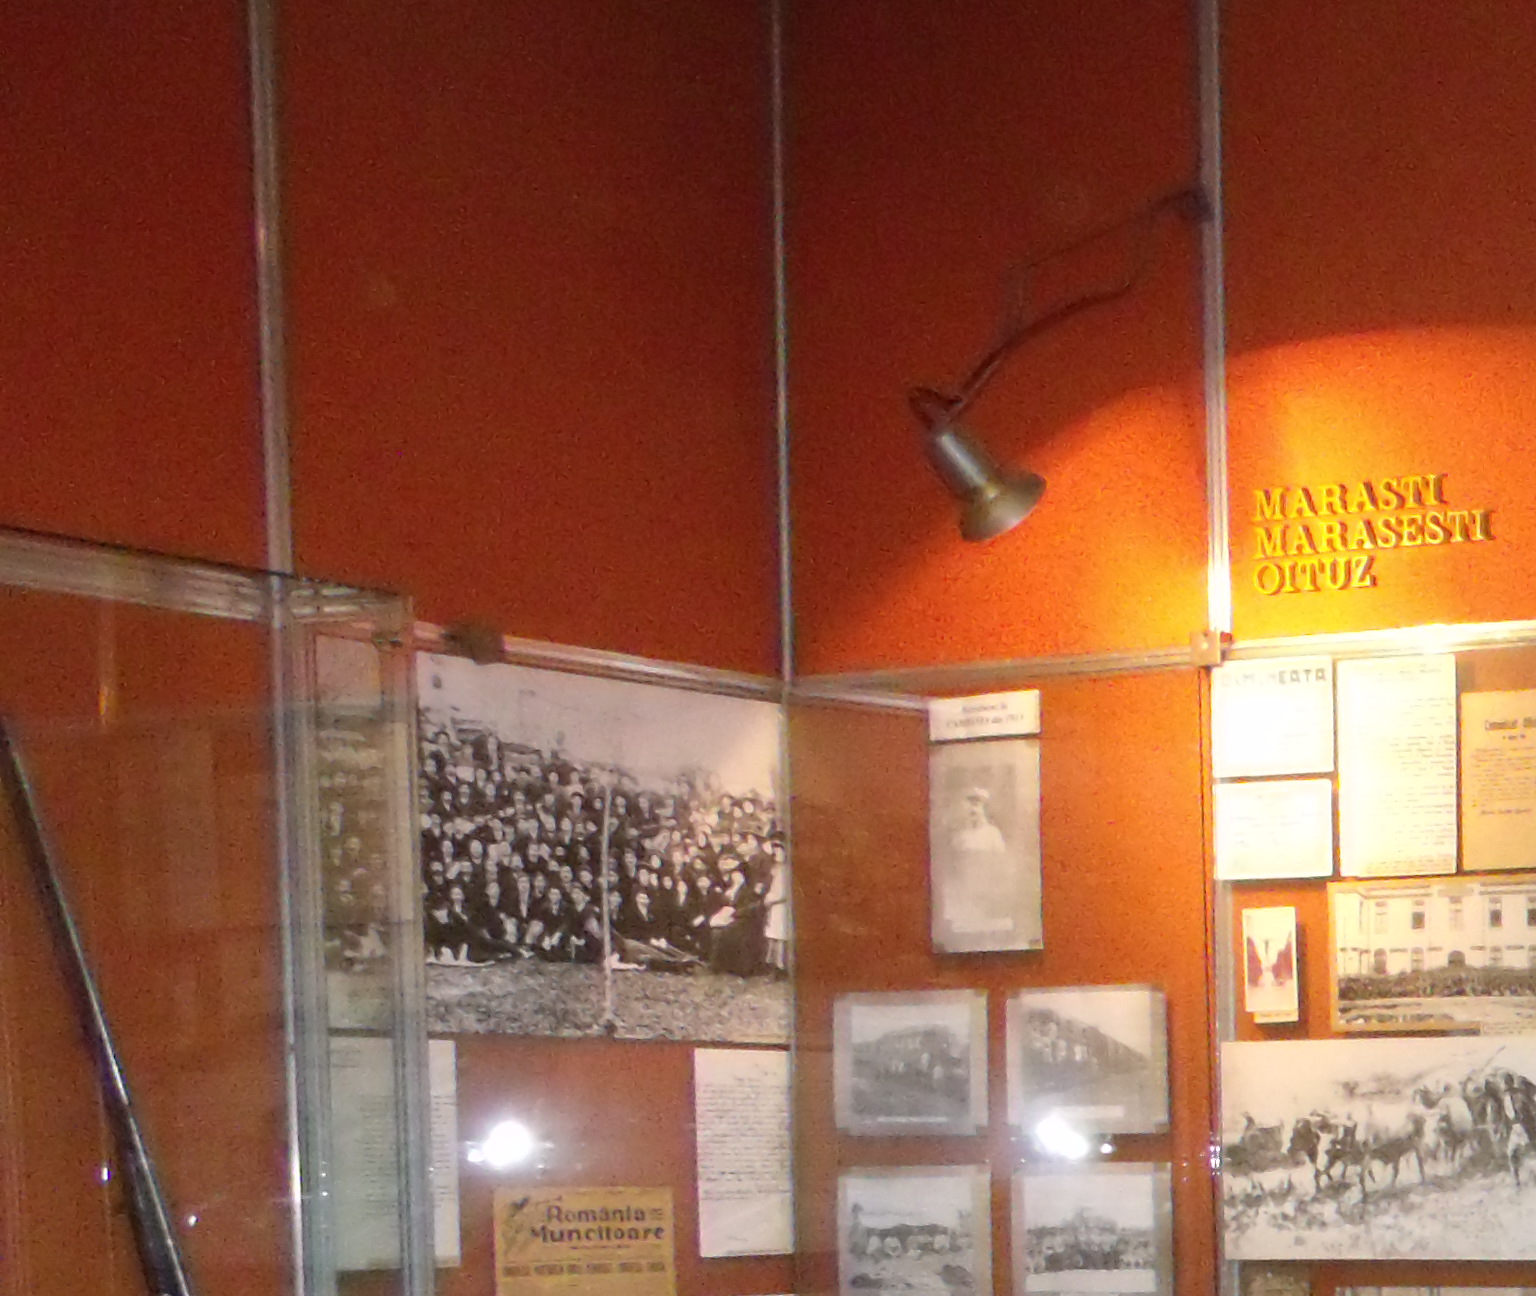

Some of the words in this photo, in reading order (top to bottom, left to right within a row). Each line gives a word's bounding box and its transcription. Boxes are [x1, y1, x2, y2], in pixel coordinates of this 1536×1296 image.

[1253, 473, 1446, 521] MARASTI
[1254, 509, 1492, 559] MARASESTI
[1255, 556, 1376, 595] OITUZ
